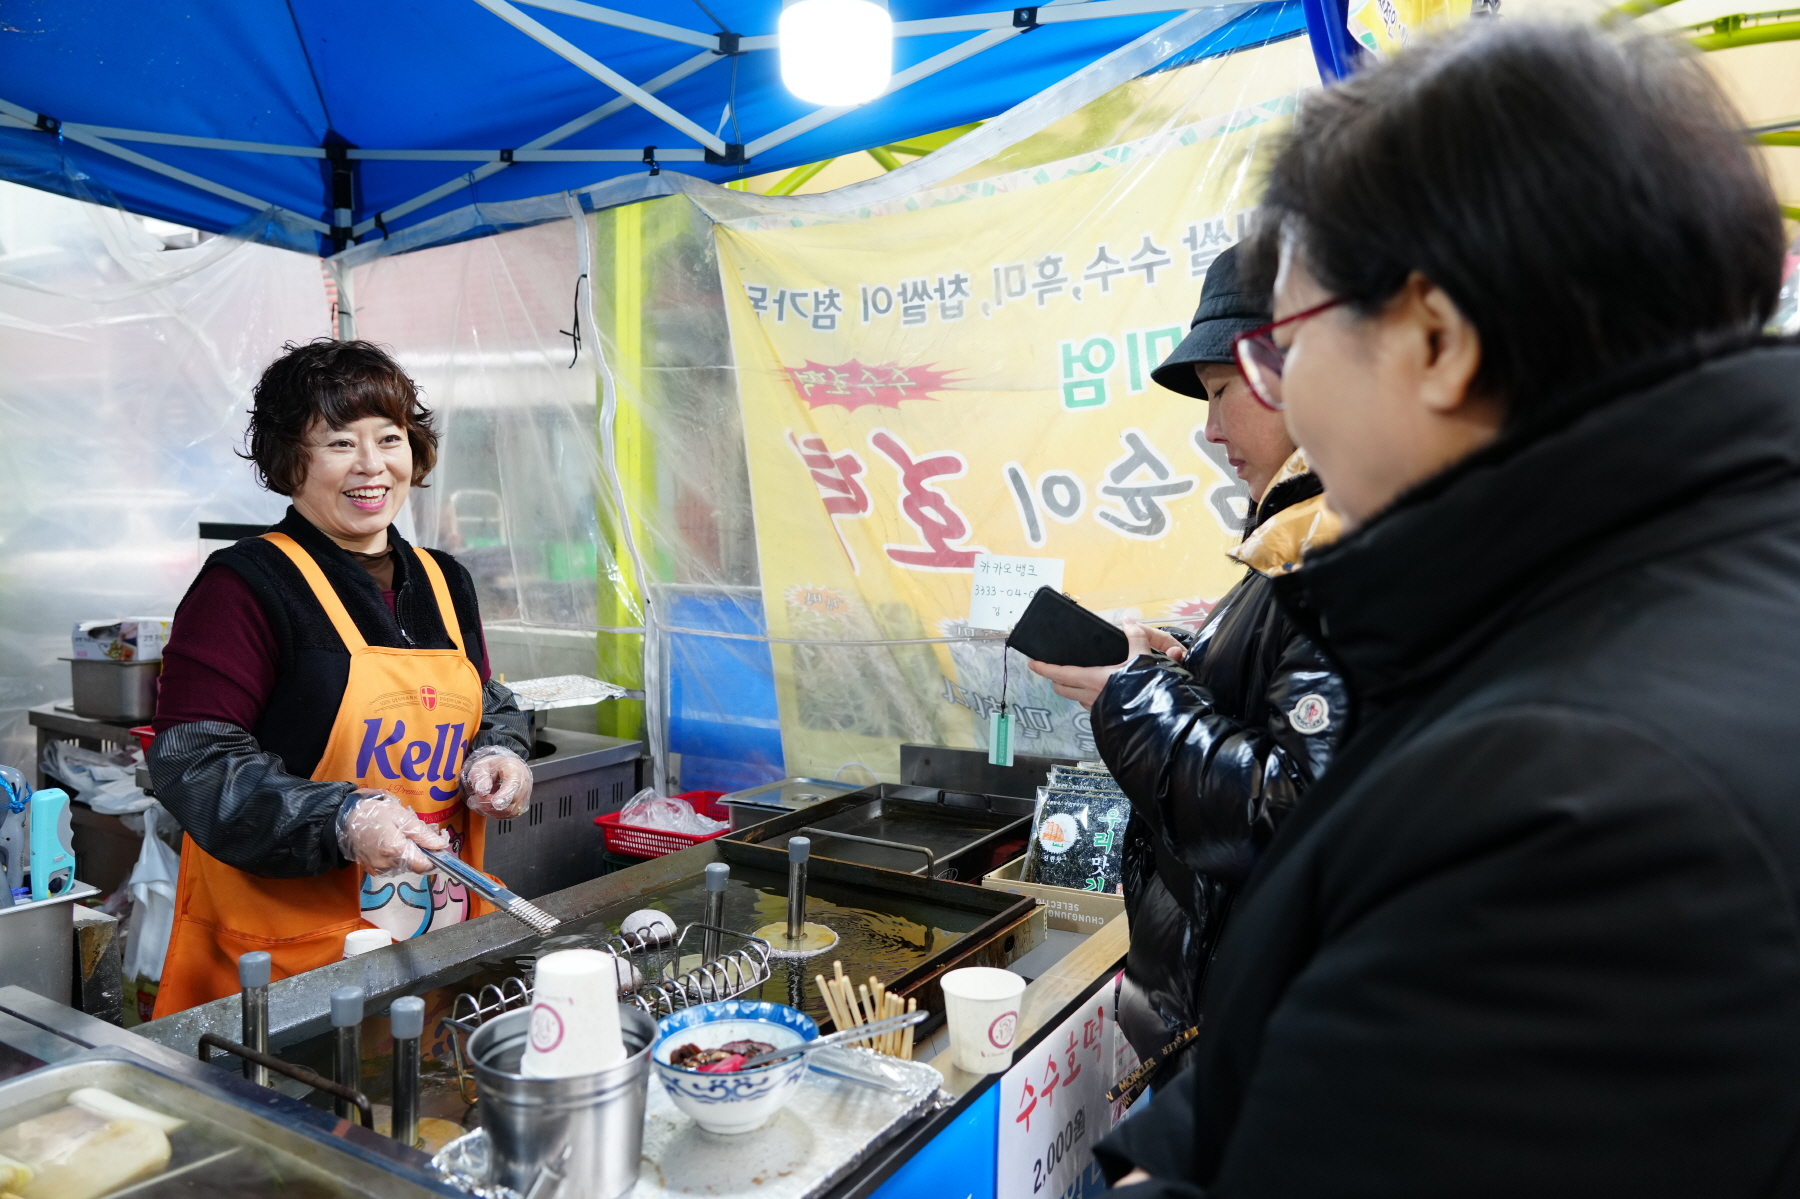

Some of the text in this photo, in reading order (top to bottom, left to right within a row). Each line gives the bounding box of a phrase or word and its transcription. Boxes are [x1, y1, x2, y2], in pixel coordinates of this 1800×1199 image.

[980, 561, 1038, 577] 카카오 뱅크
[1035, 898, 1080, 912] SELECTIO
[1016, 1005, 1104, 1132] 수수호떡
[1118, 1057, 1157, 1093] MONCLER
[1033, 1105, 1086, 1195] 2,000원
